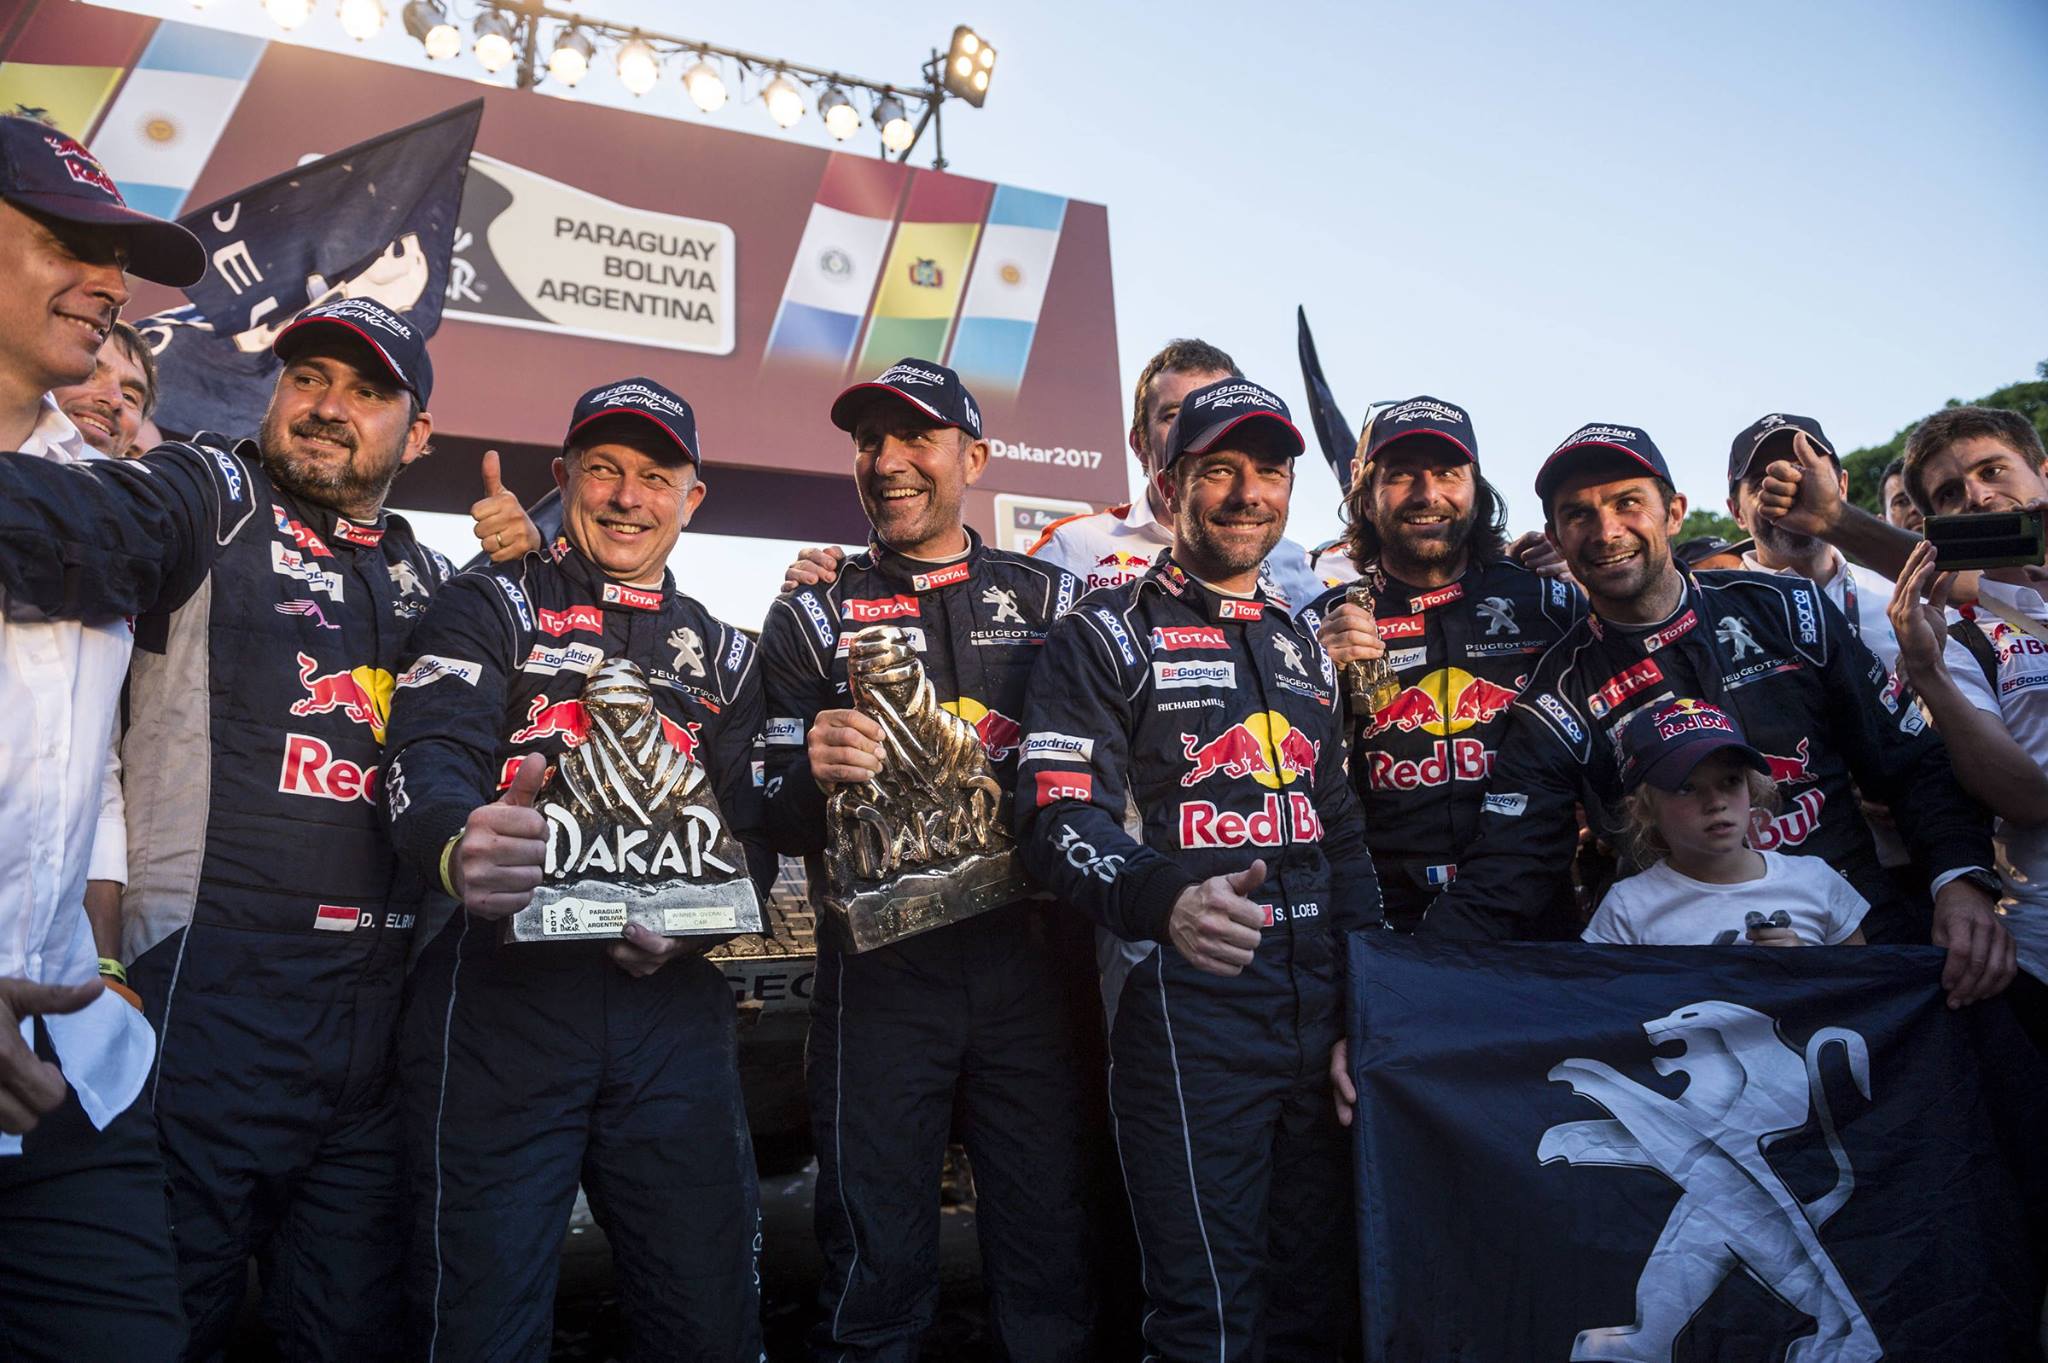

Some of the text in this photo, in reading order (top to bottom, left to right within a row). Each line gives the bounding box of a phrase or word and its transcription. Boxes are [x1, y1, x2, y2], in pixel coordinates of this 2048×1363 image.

[555, 217, 716, 262] PARAGUAY
[604, 256, 716, 293] BOLIVIA
[537, 279, 715, 324] ARGENTINA
[881, 373, 934, 387] ACING
[603, 395, 676, 416] RACING
[1212, 395, 1278, 411] RACING
[1395, 411, 1457, 423] RACING
[987, 438, 1103, 470] Dakar2017
[930, 569, 968, 585] TOTAL
[1087, 571, 1122, 589] Red
[622, 591, 660, 608] TOTAL
[1425, 587, 1463, 606] TOTAL
[855, 601, 917, 617] TOTAL
[1237, 605, 1261, 617] TOTA
[1792, 589, 1818, 644] sparco
[541, 610, 602, 632] TOTAL
[798, 591, 834, 649] sparco
[1377, 621, 1422, 636] OTAL
[1662, 616, 1696, 639] TOTAL
[971, 630, 1029, 639] PEUGEOT
[1096, 608, 1137, 666] sparco
[1165, 630, 1228, 646] TOTAL
[527, 647, 595, 665] BFGodrich
[1161, 666, 1231, 679] BFGoodrich
[1604, 669, 1658, 698] TOTAL
[1157, 699, 1201, 712] RICHARD
[1537, 693, 1584, 743] sparco
[1659, 714, 1734, 741] Red Bull
[1365, 740, 1450, 792] Red
[1179, 793, 1284, 850] Red
[1745, 788, 1826, 851] Bull
[543, 802, 737, 879] DAKAR
[359, 912, 376, 928] D.
[1275, 904, 1319, 921] S. LOEB
